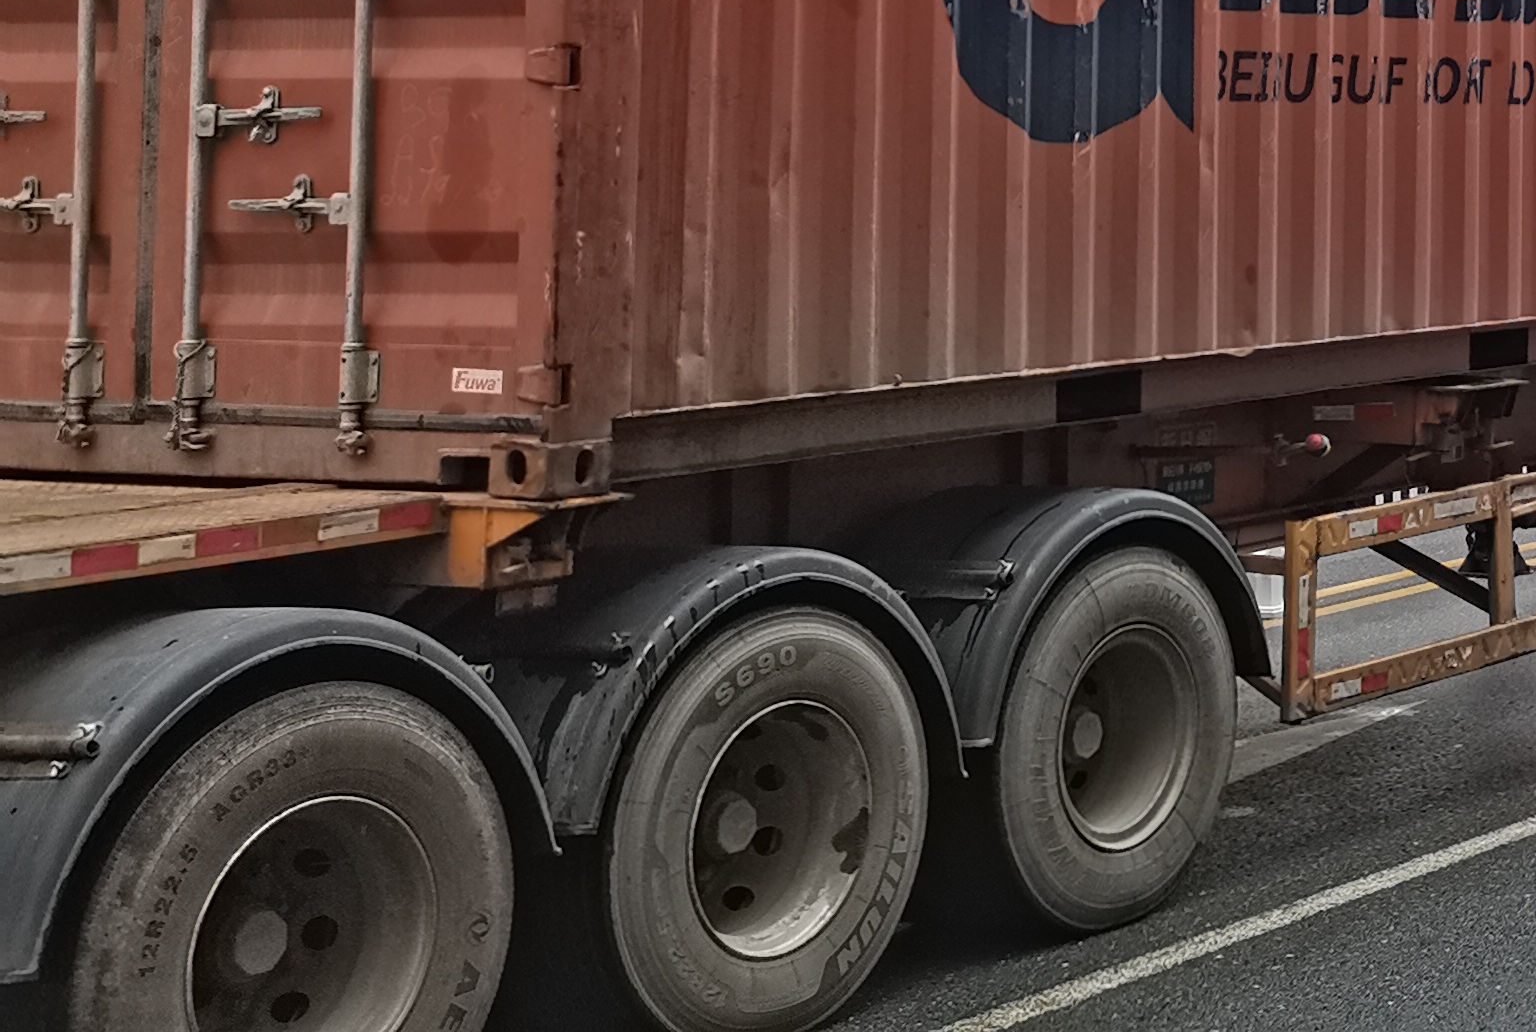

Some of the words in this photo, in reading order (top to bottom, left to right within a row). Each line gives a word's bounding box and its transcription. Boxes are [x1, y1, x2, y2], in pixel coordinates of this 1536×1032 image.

[1216, 50, 1318, 103] BEIU
[1331, 54, 1408, 106] GUF
[454, 370, 497, 390] Fuwa
[714, 644, 798, 707] S690
